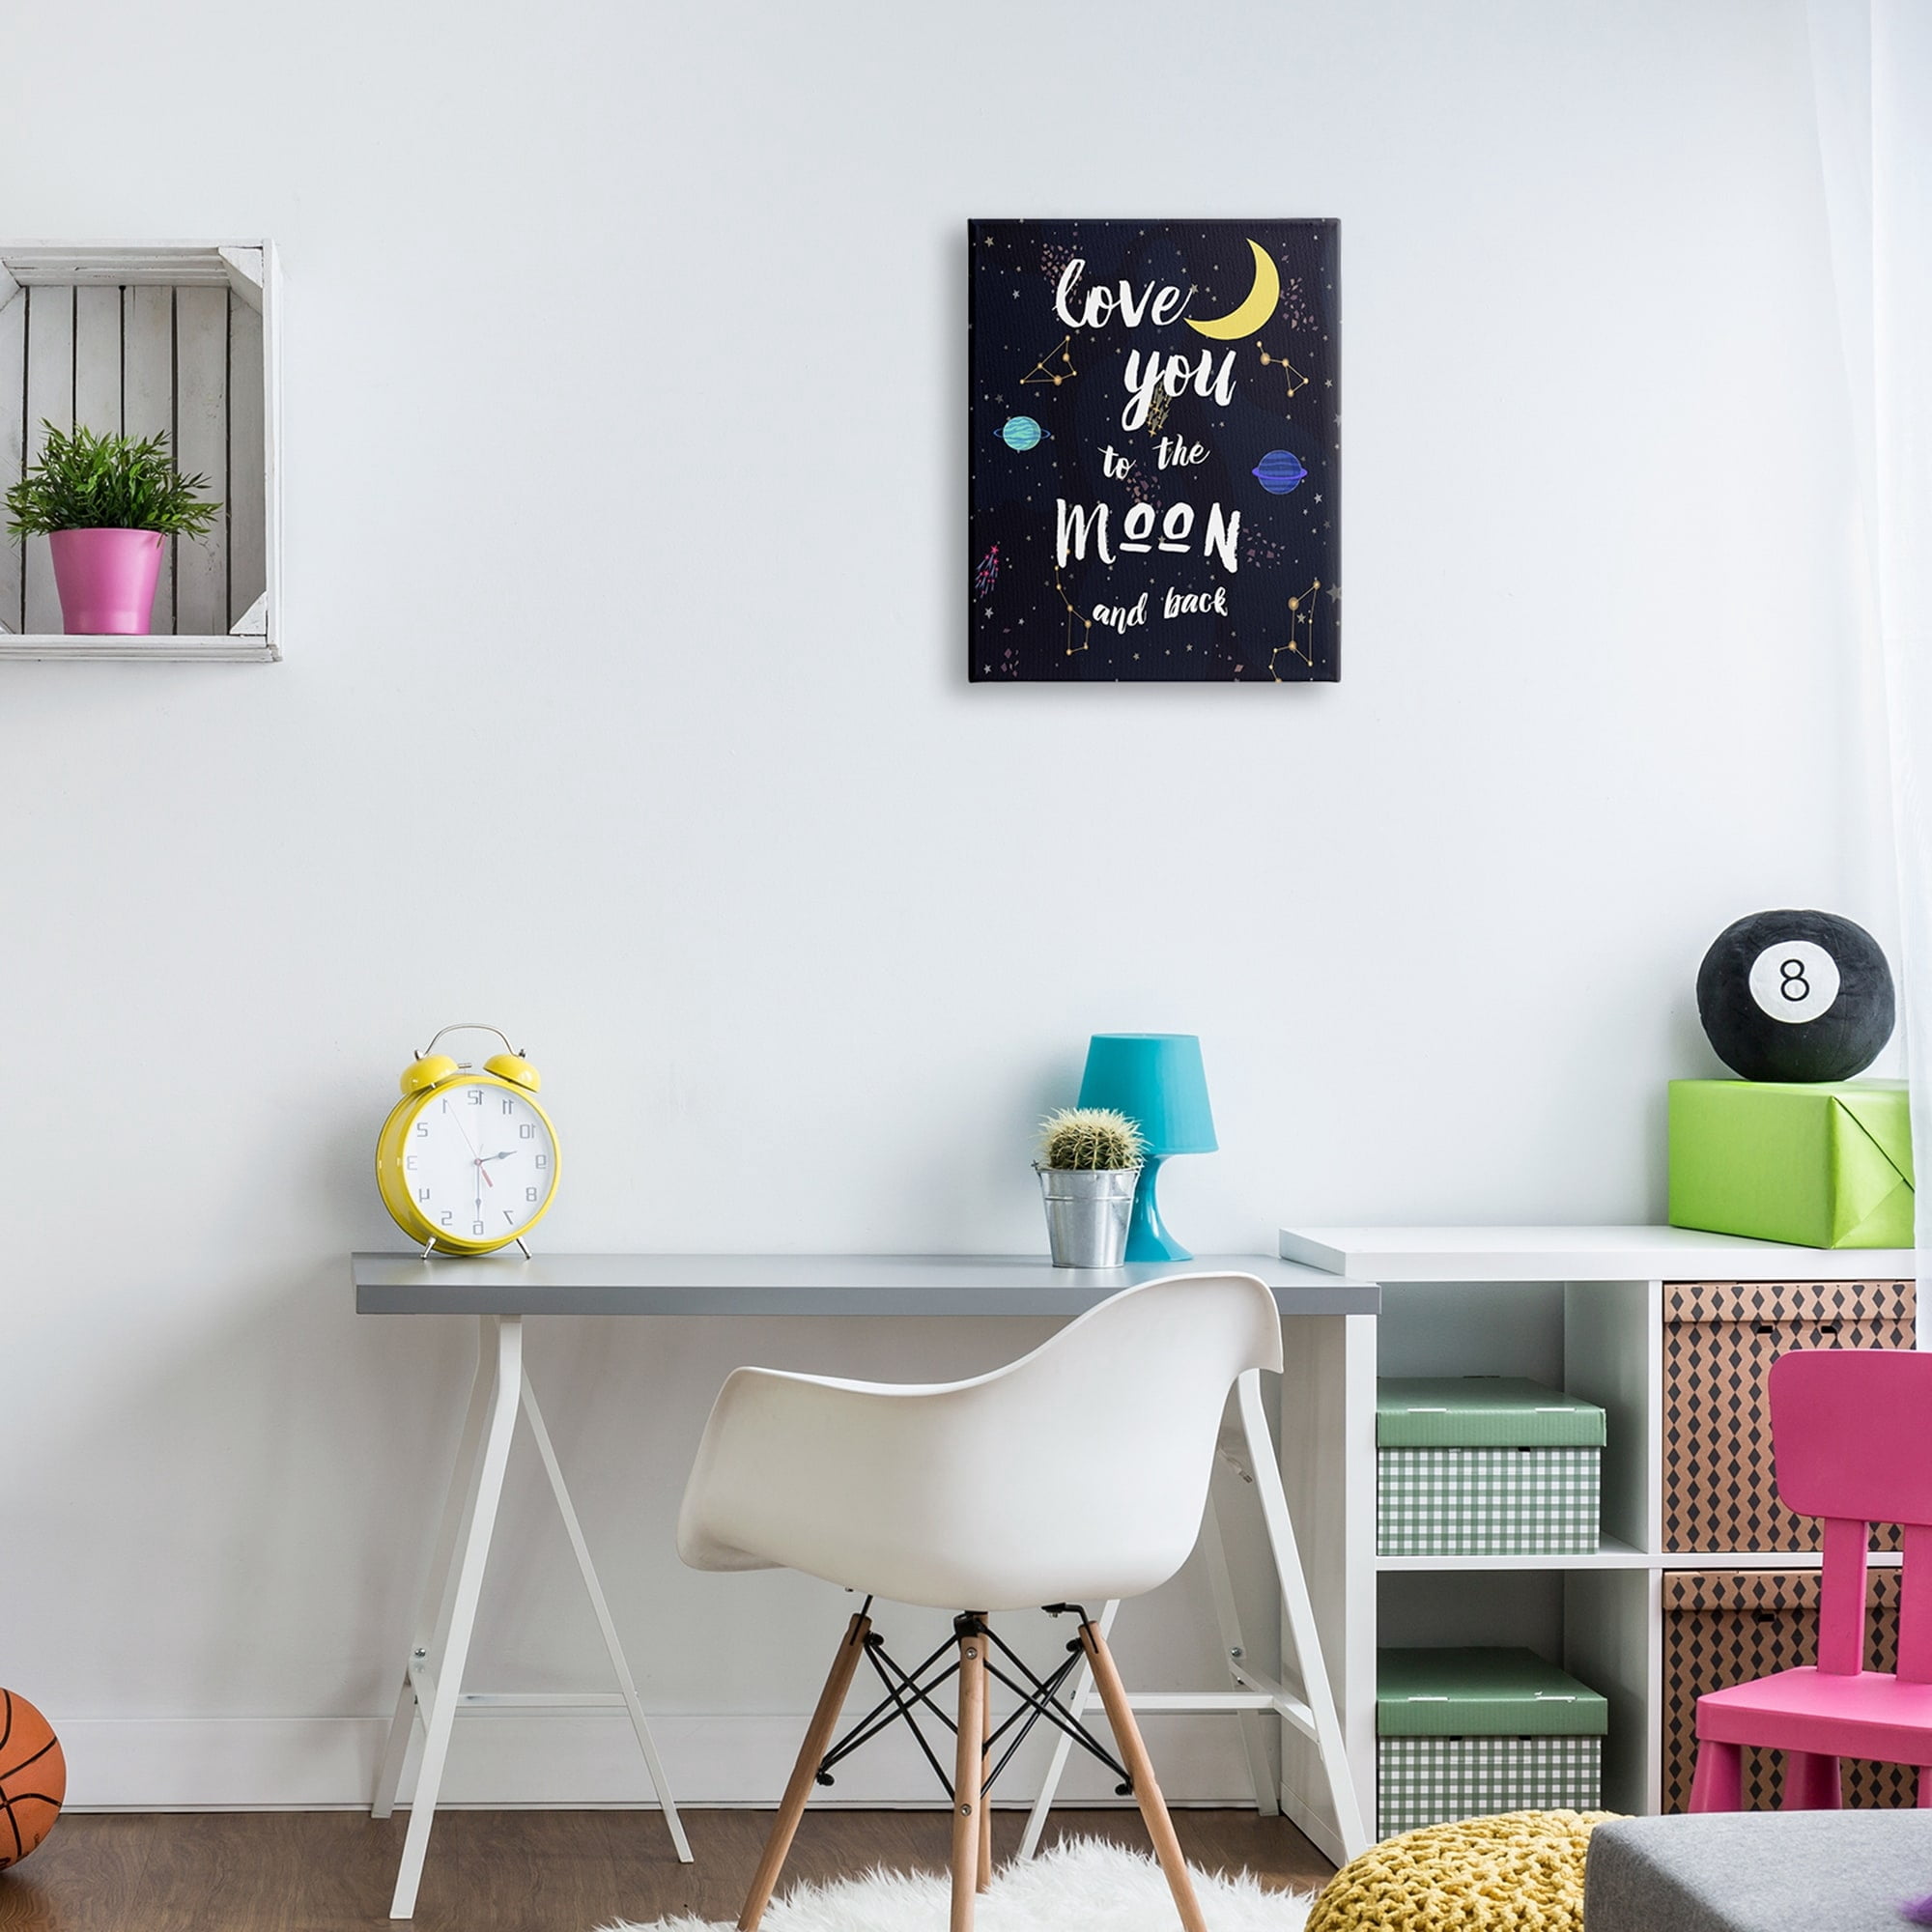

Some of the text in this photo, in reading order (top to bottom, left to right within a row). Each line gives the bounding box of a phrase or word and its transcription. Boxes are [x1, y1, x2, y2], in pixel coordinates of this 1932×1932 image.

[1122, 350, 1236, 432] you
[1098, 435, 1209, 479] to the
[1093, 587, 1227, 634] and back
[1780, 958, 1810, 1002] 8
